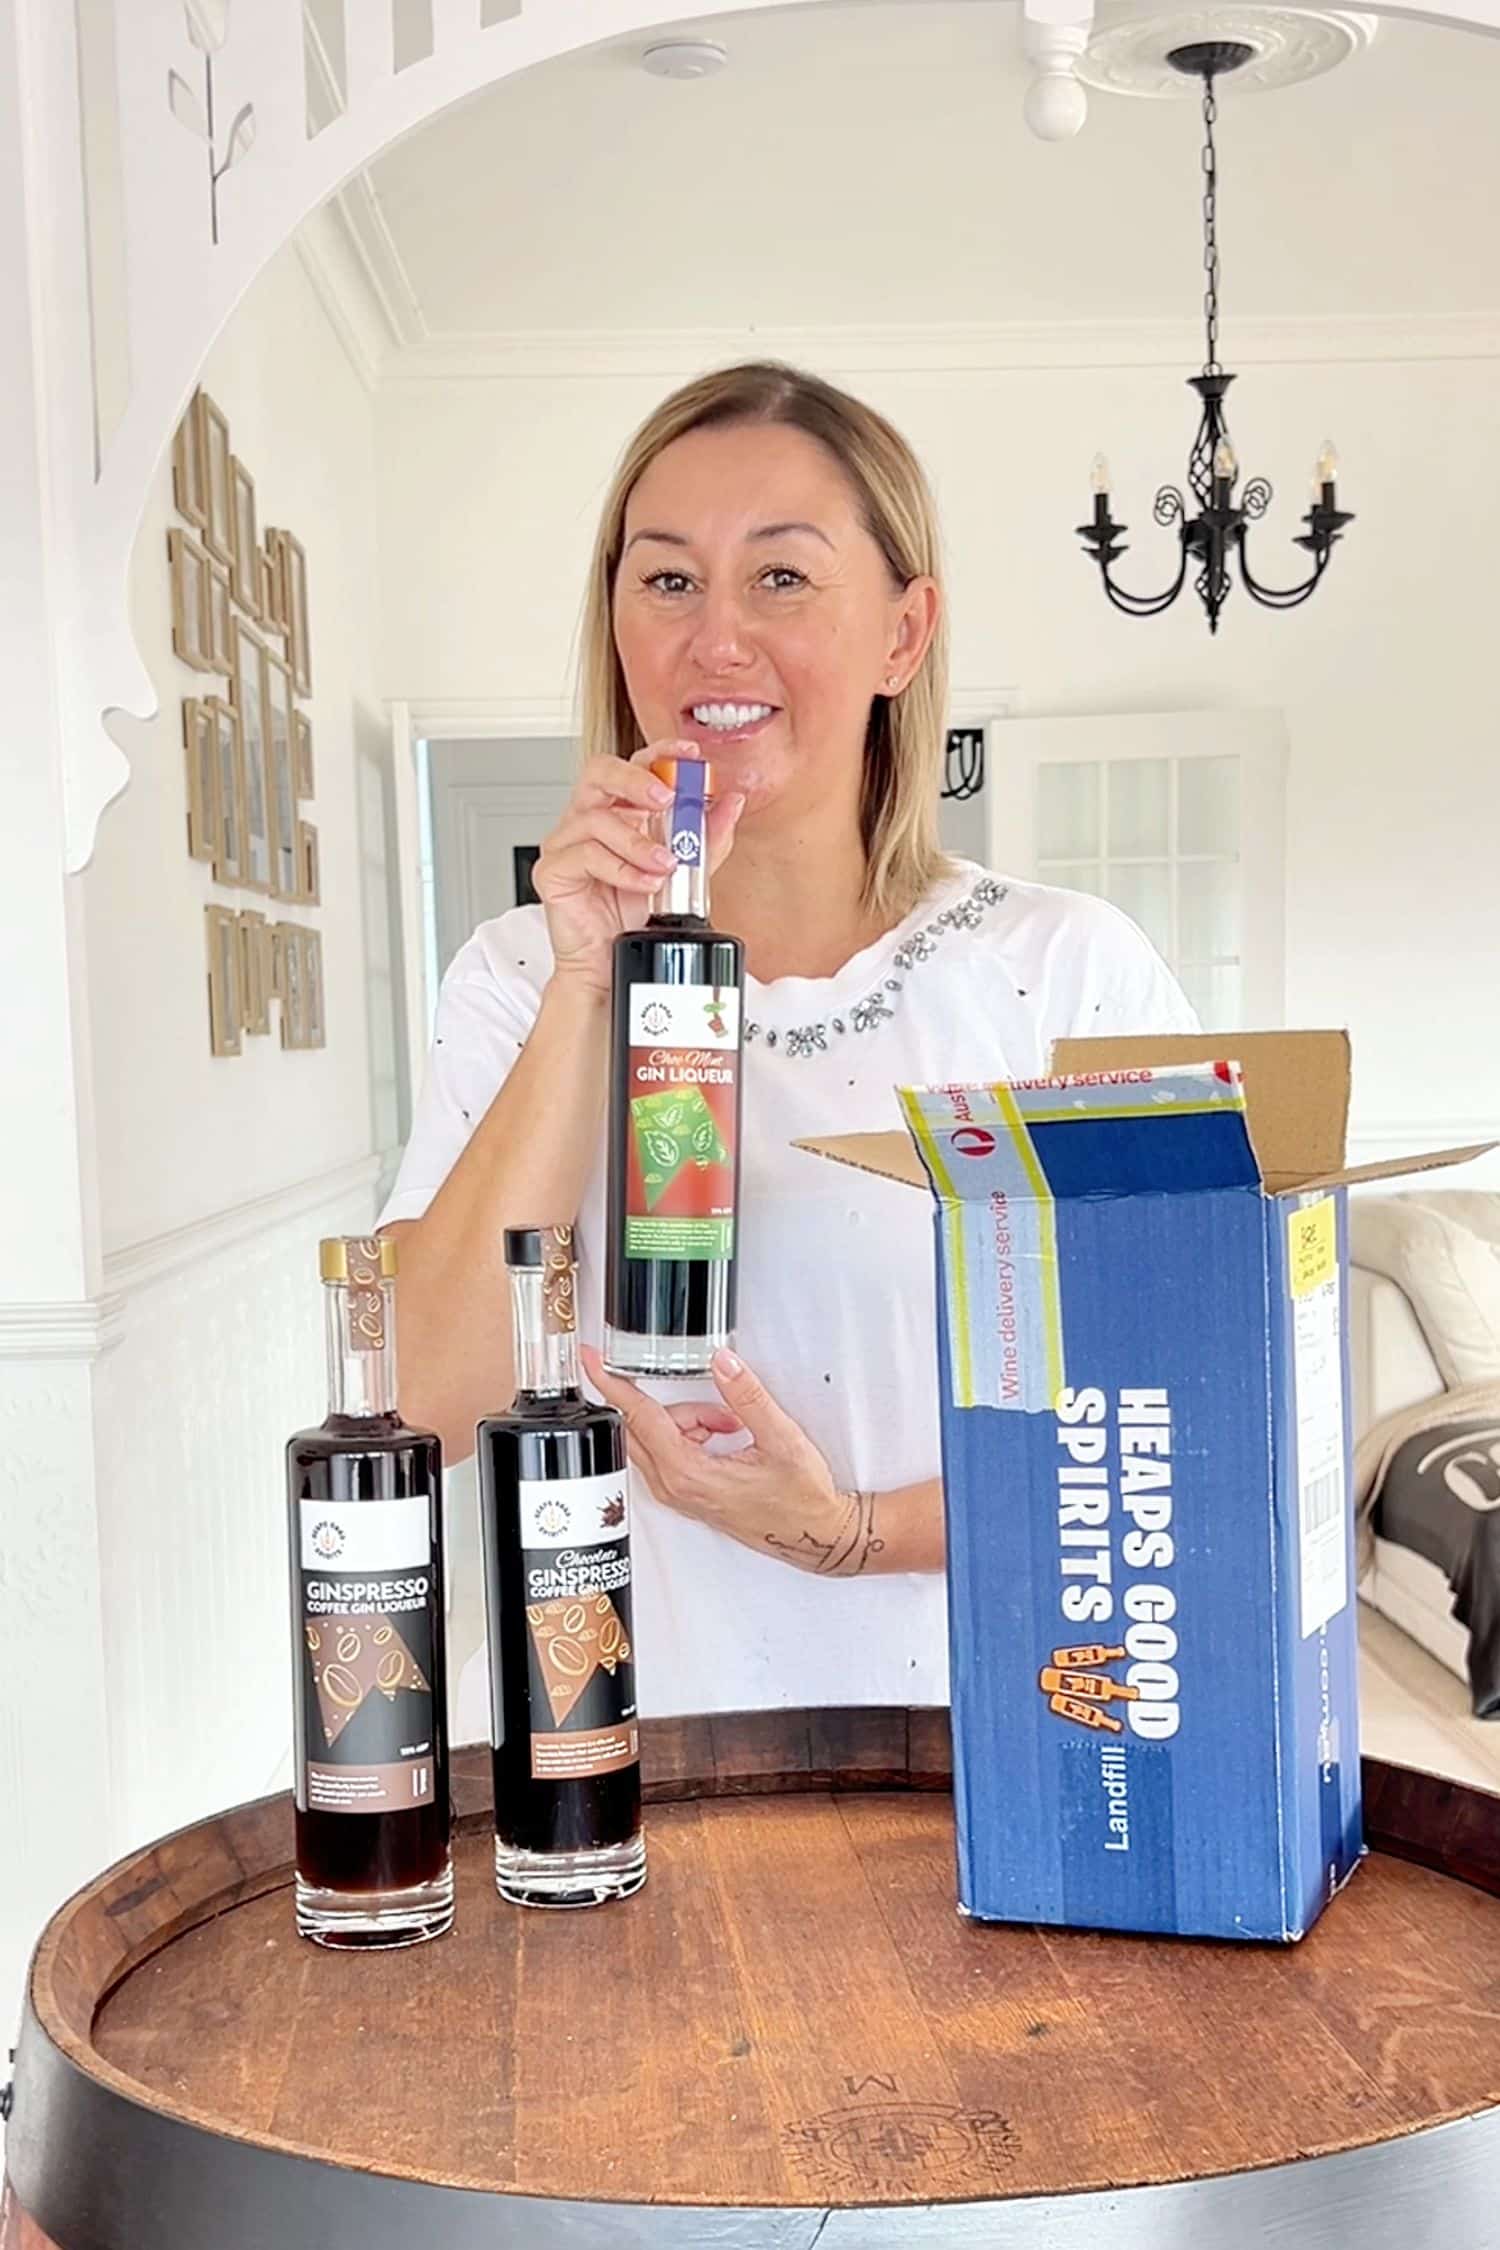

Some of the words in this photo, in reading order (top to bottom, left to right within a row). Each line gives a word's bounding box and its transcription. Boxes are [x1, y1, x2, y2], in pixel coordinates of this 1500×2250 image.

[636, 1067, 665, 1082] GIN
[669, 1067, 733, 1084] LIQUEUR
[1073, 1069, 1153, 1087] service
[991, 1190, 1011, 1257] service
[996, 1259, 1016, 1343] delivery
[1000, 1347, 1018, 1399] Wine
[1056, 1387, 1113, 1623] SPIRITS
[1117, 1387, 1176, 1569] HEAPS
[307, 1577, 428, 1601] GINSPRESSO
[307, 1600, 349, 1614] COFFEE
[350, 1601, 376, 1615] GIN
[377, 1597, 427, 1613] LIQUEUR
[530, 1585, 577, 1598] COFFEE
[578, 1582, 600, 1596] GIN
[1123, 1583, 1181, 1740] GOOD
[1100, 1746, 1129, 1851] Landfill
